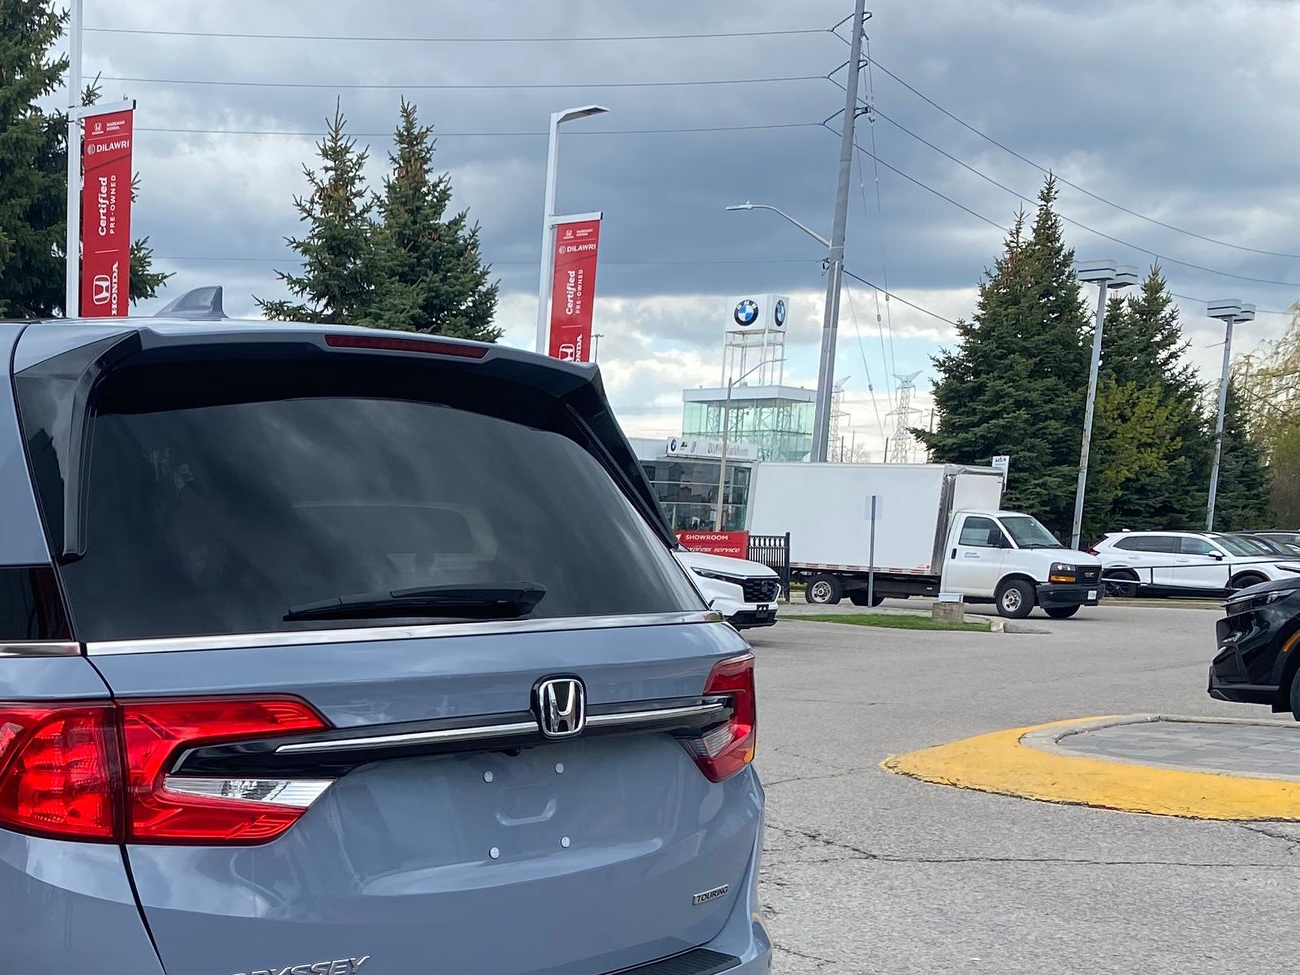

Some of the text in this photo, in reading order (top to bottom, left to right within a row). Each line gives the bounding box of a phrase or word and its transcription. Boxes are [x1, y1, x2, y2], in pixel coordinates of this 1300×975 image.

[96, 140, 130, 153] DILAWRI
[98, 176, 109, 236] Certified
[109, 175, 117, 235] PRE-OWNED
[566, 243, 597, 253] DILAWRI
[111, 261, 119, 316] HONDA
[565, 270, 576, 315] Certified
[696, 886, 729, 903] TOURING
